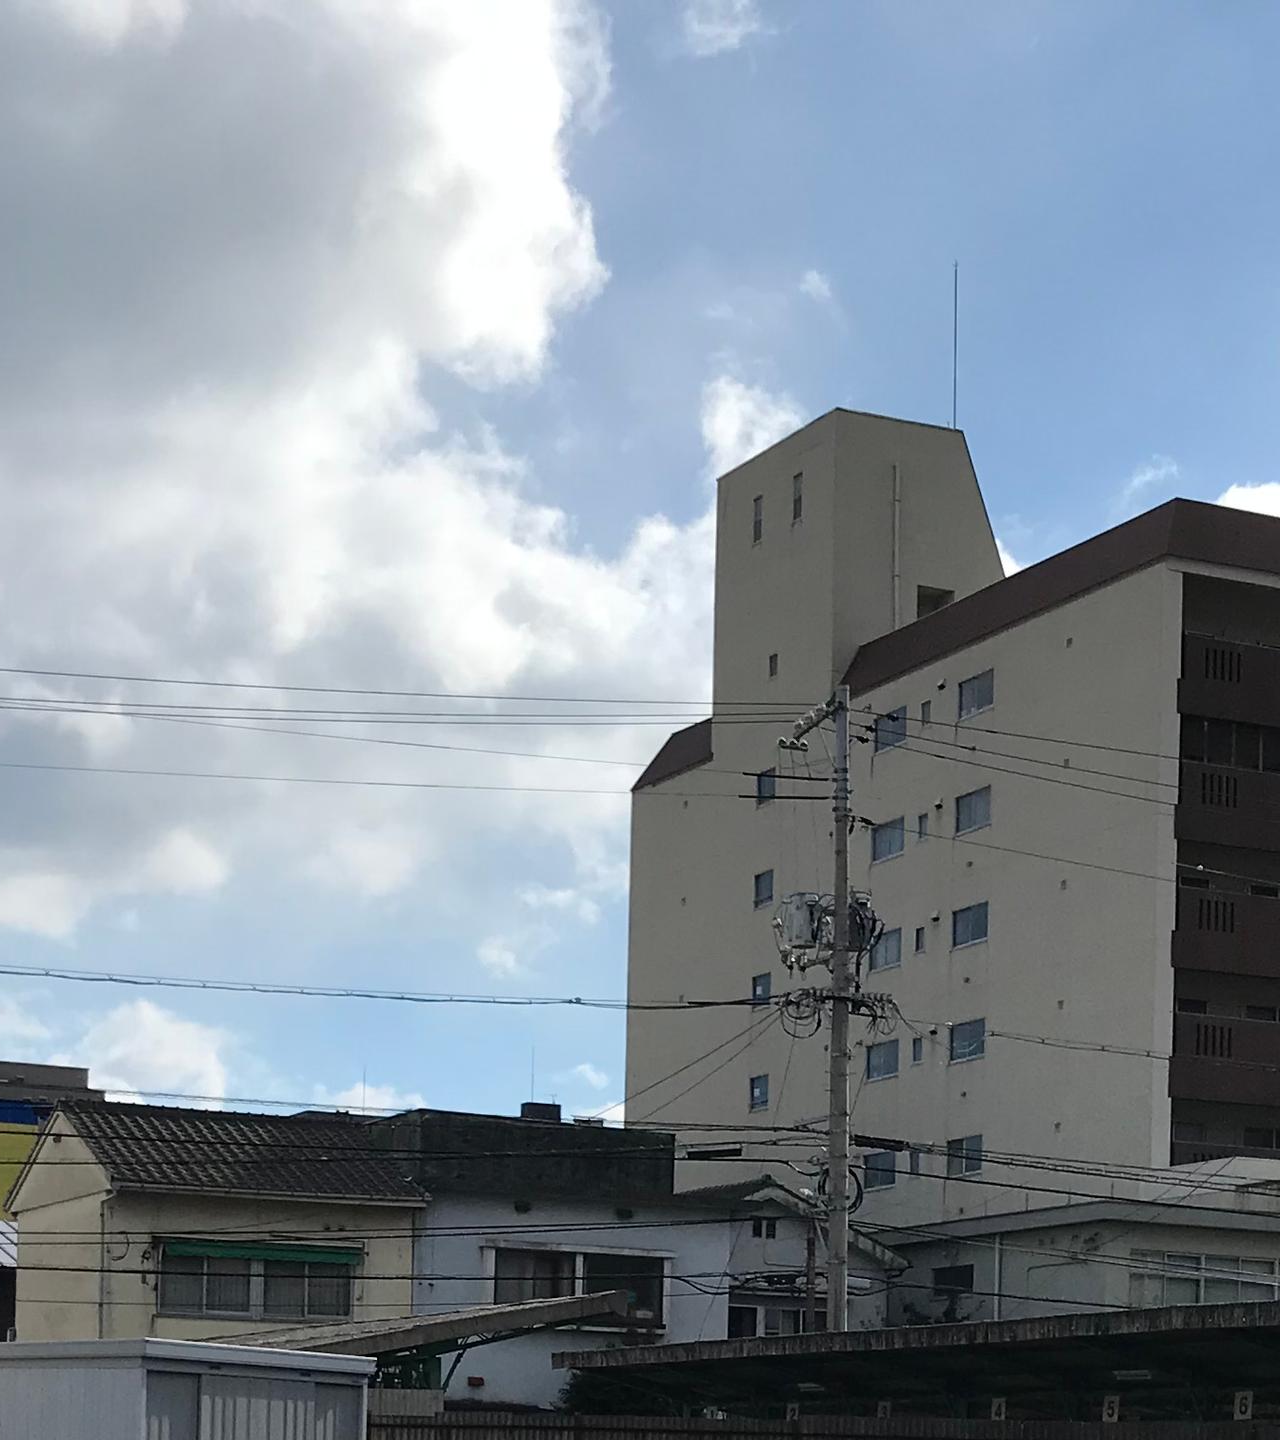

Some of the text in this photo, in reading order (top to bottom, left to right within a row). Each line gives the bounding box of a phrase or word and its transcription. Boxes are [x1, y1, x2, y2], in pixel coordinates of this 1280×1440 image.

[993, 1402, 1003, 1418] 4
[1106, 1401, 1116, 1419] 5
[1238, 1396, 1248, 1415] 6
